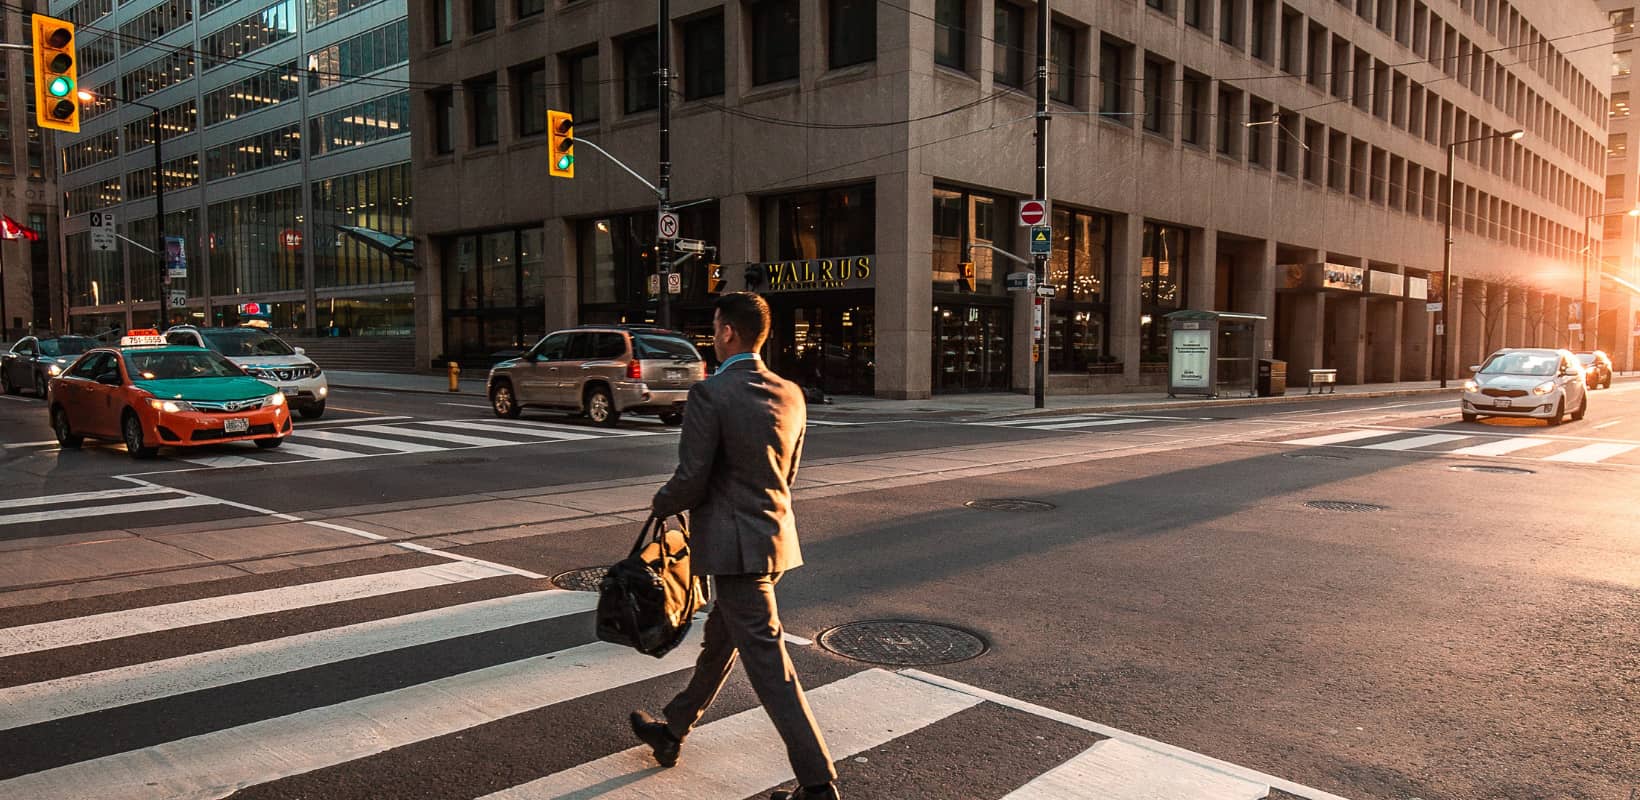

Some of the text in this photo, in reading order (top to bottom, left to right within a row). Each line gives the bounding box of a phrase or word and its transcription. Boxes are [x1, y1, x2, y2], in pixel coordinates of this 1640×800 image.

[766, 256, 870, 284] WALRUS
[172, 297, 186, 306] 40
[129, 336, 162, 344] 751-5555
